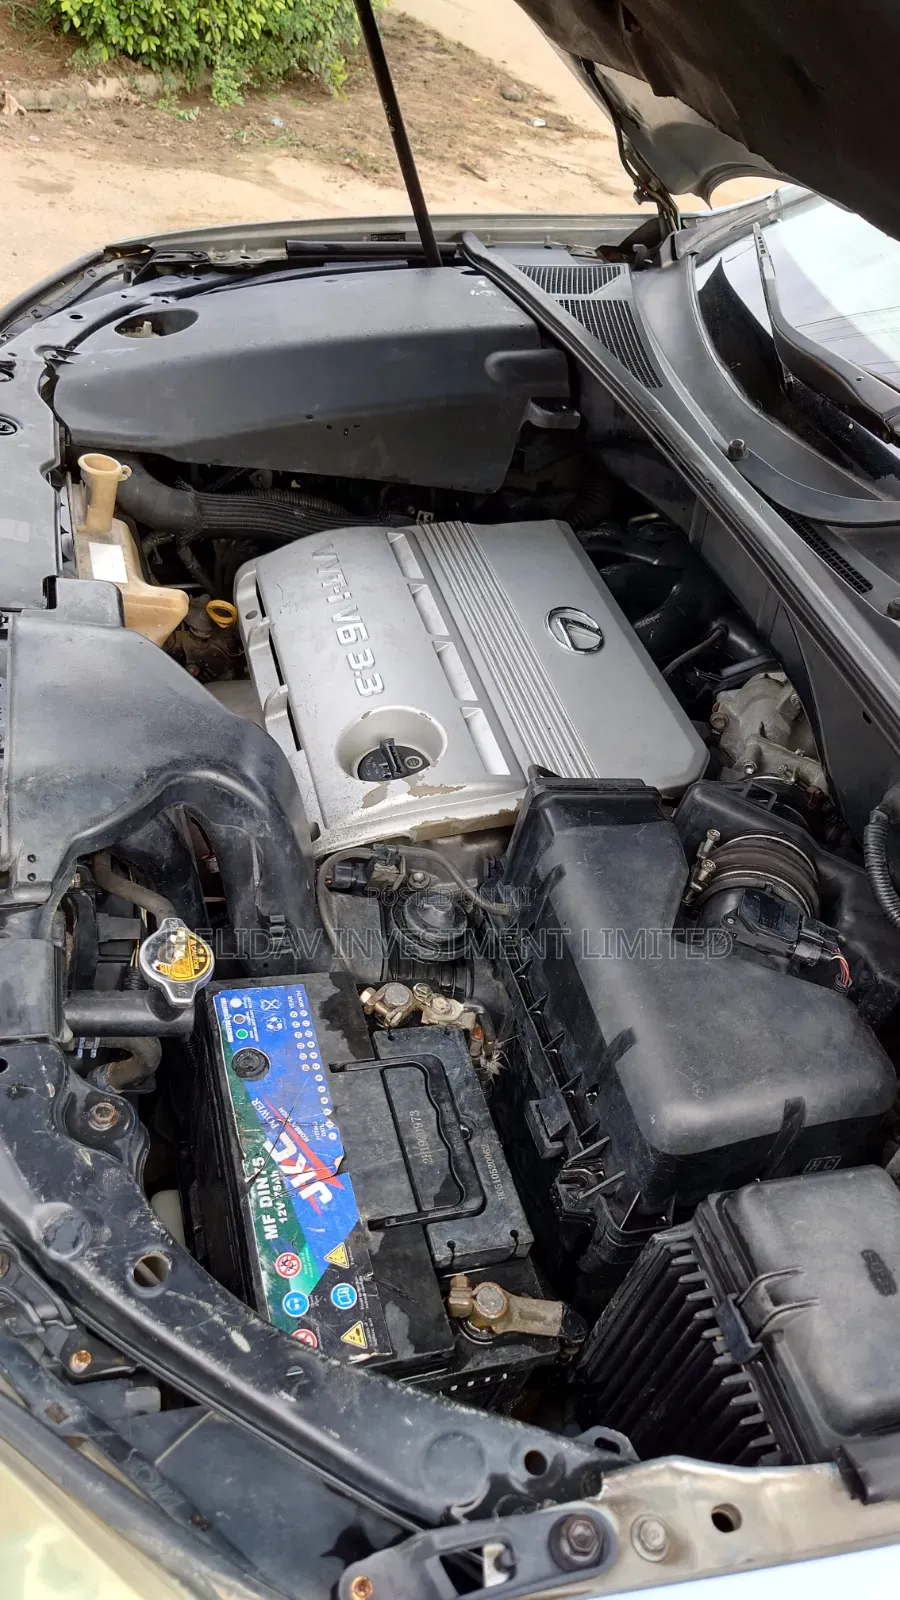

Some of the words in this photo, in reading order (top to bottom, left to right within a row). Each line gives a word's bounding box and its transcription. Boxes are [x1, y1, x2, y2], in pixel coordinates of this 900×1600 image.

[331, 604, 370, 646] V6
[346, 648, 385, 697] 3.3
[251, 1097, 280, 1130] POWER
[262, 1131, 333, 1205] JKC
[262, 1214, 279, 1240] MF
[276, 1202, 289, 1224] 12V
